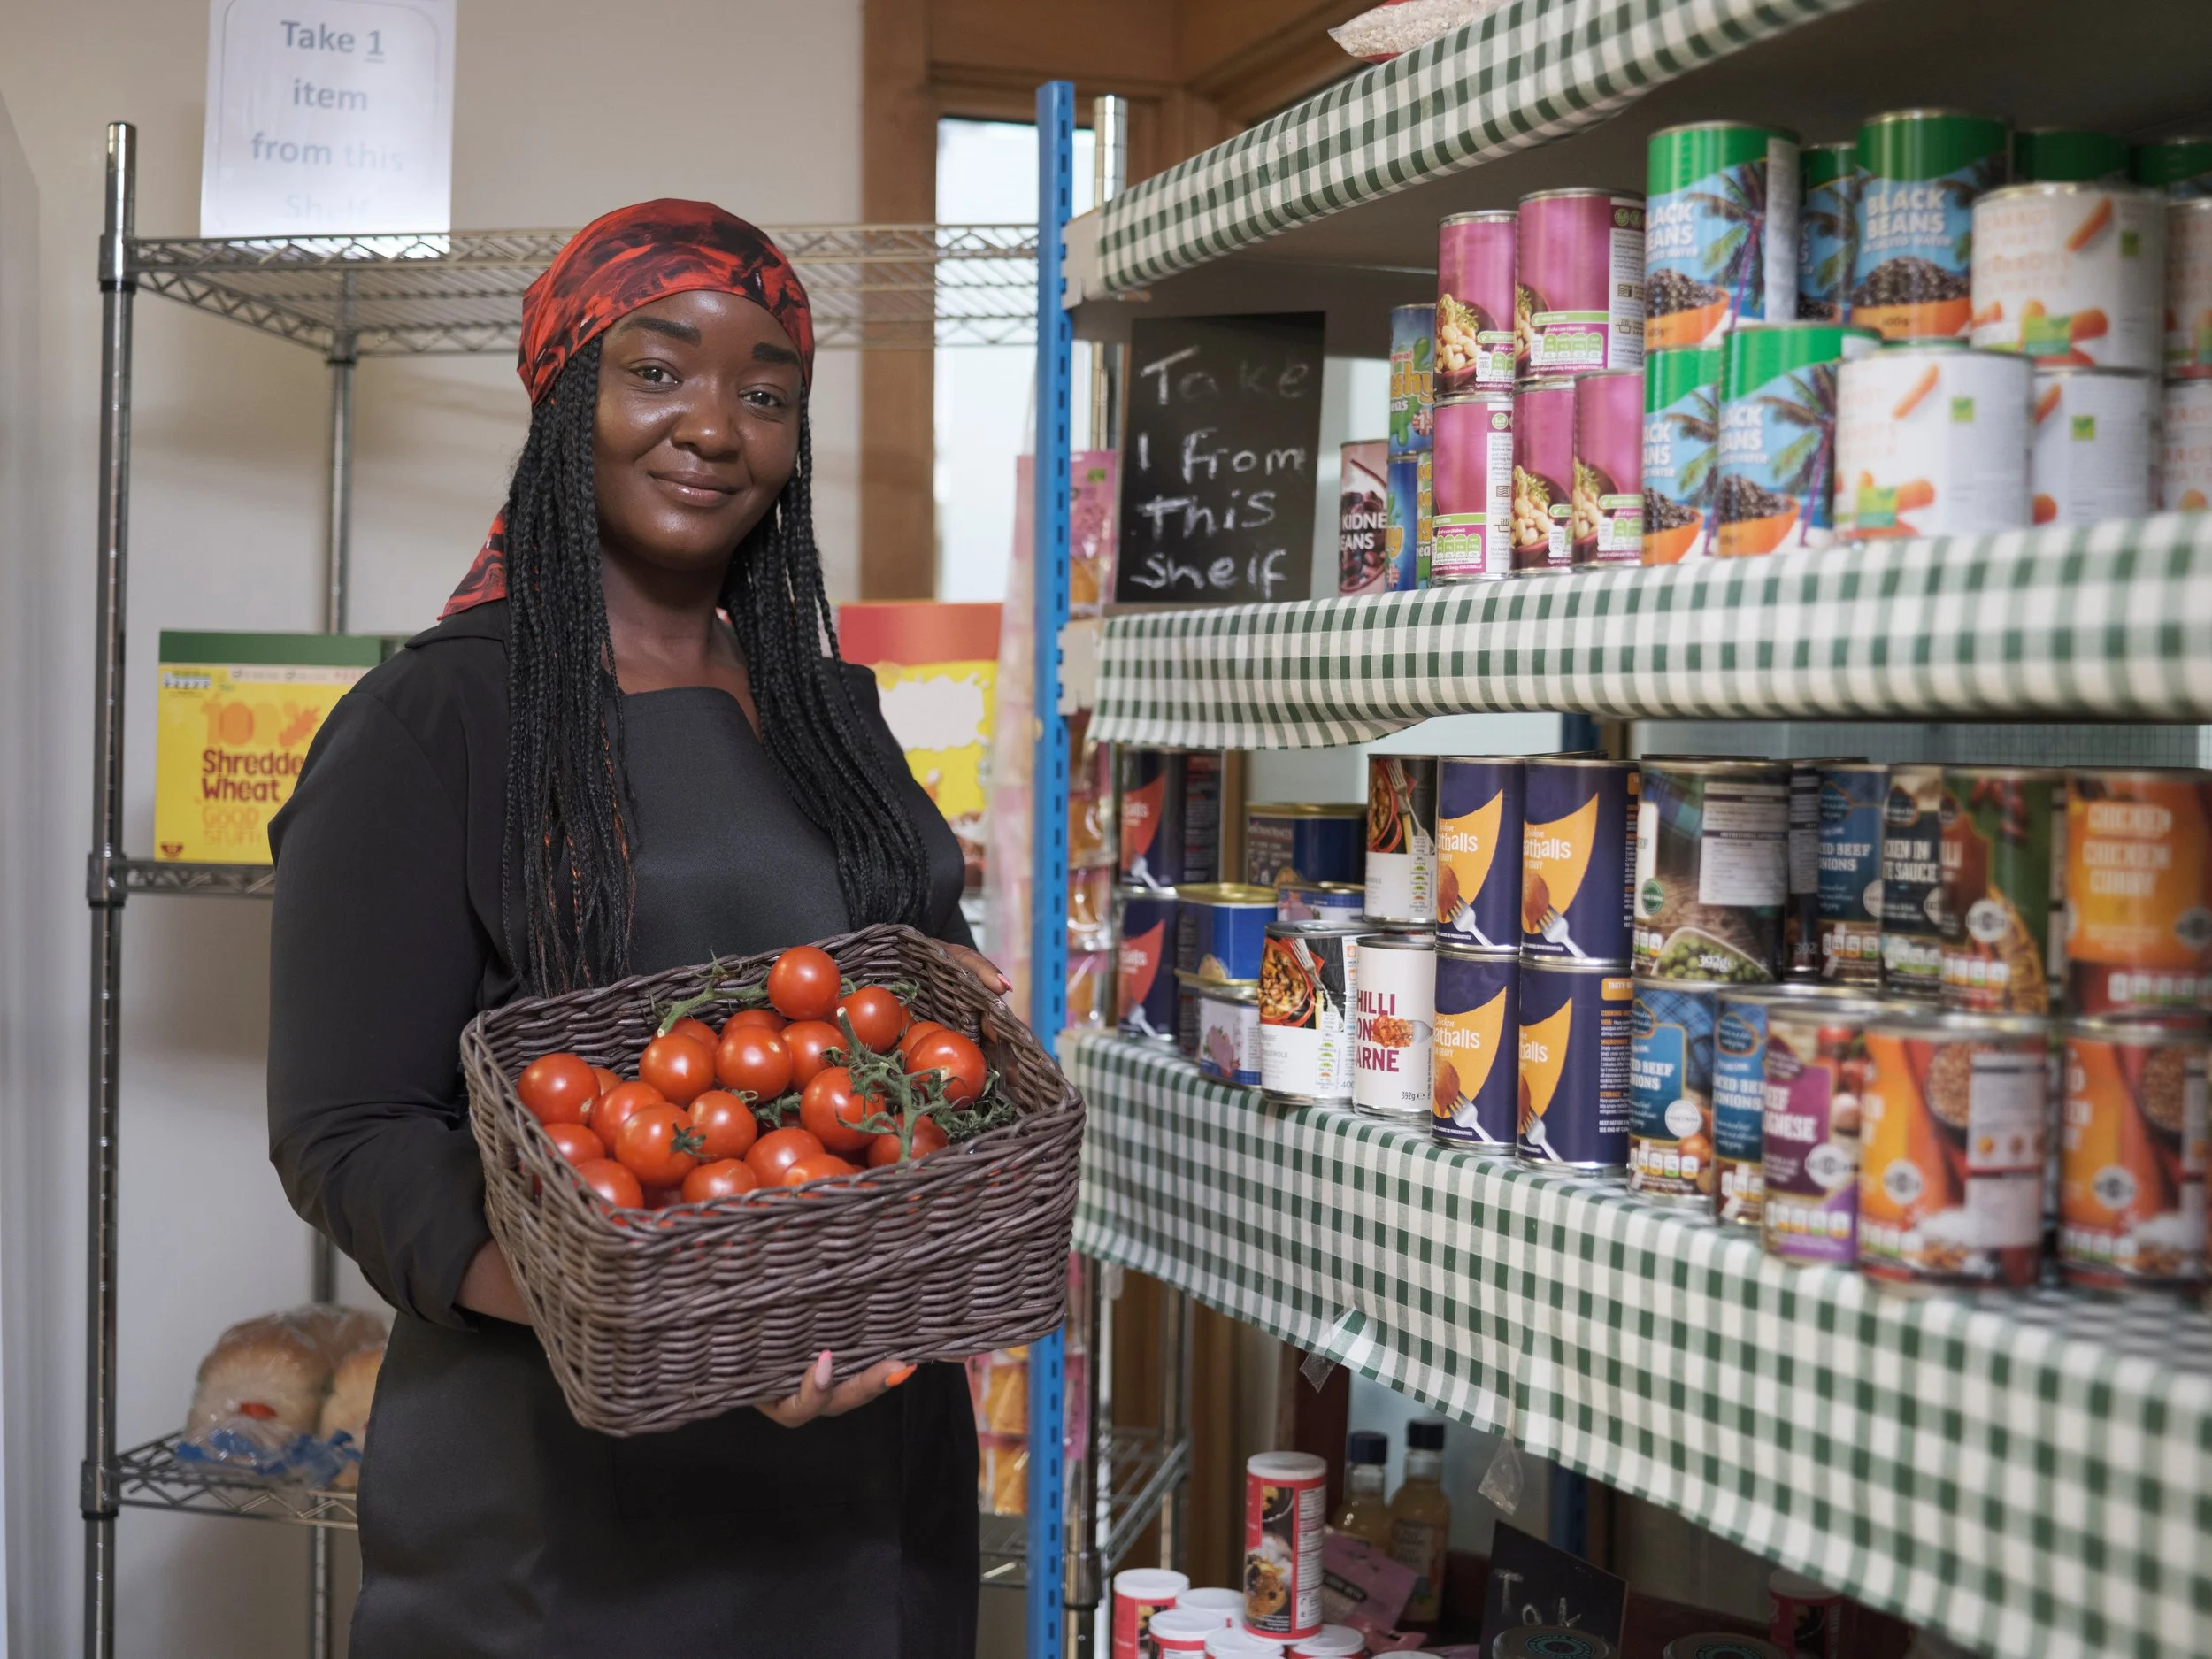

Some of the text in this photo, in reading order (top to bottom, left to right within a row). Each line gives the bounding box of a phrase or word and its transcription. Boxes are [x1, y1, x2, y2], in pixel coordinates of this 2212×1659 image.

[280, 20, 386, 63] Take 1
[293, 79, 367, 111] item
[251, 132, 403, 172] from this
[1647, 202, 1694, 225] LACK
[1866, 189, 1946, 215] BLACK
[1647, 224, 1693, 247] EANS
[1866, 213, 1944, 239] BEANS
[1140, 345, 1310, 405] Take
[1391, 361, 1435, 404] shy
[1722, 405, 1763, 427] ACK
[1642, 422, 1671, 442] ACK
[1720, 429, 1763, 452] ANS
[1642, 446, 1671, 465] ANS
[1341, 511, 1386, 530] KIDNE
[1340, 533, 1374, 551] EANS
[202, 776, 281, 803] Wheat
[1524, 838, 1571, 860] atballs
[1835, 843, 1871, 856] BEEF
[1818, 857, 1857, 872] NIONS
[1895, 863, 1938, 883] SAUCE
[1357, 989, 1395, 1016] HILLI
[1356, 1018, 1372, 1042] ON
[1434, 1027, 1480, 1049] atballs
[1356, 1048, 1400, 1072] ARNE
[1519, 1041, 1548, 1063] balls
[1642, 1060, 1675, 1077] BEEF
[1402, 1091, 1416, 1101] 392g
[1494, 1568, 1582, 1627] Tak
